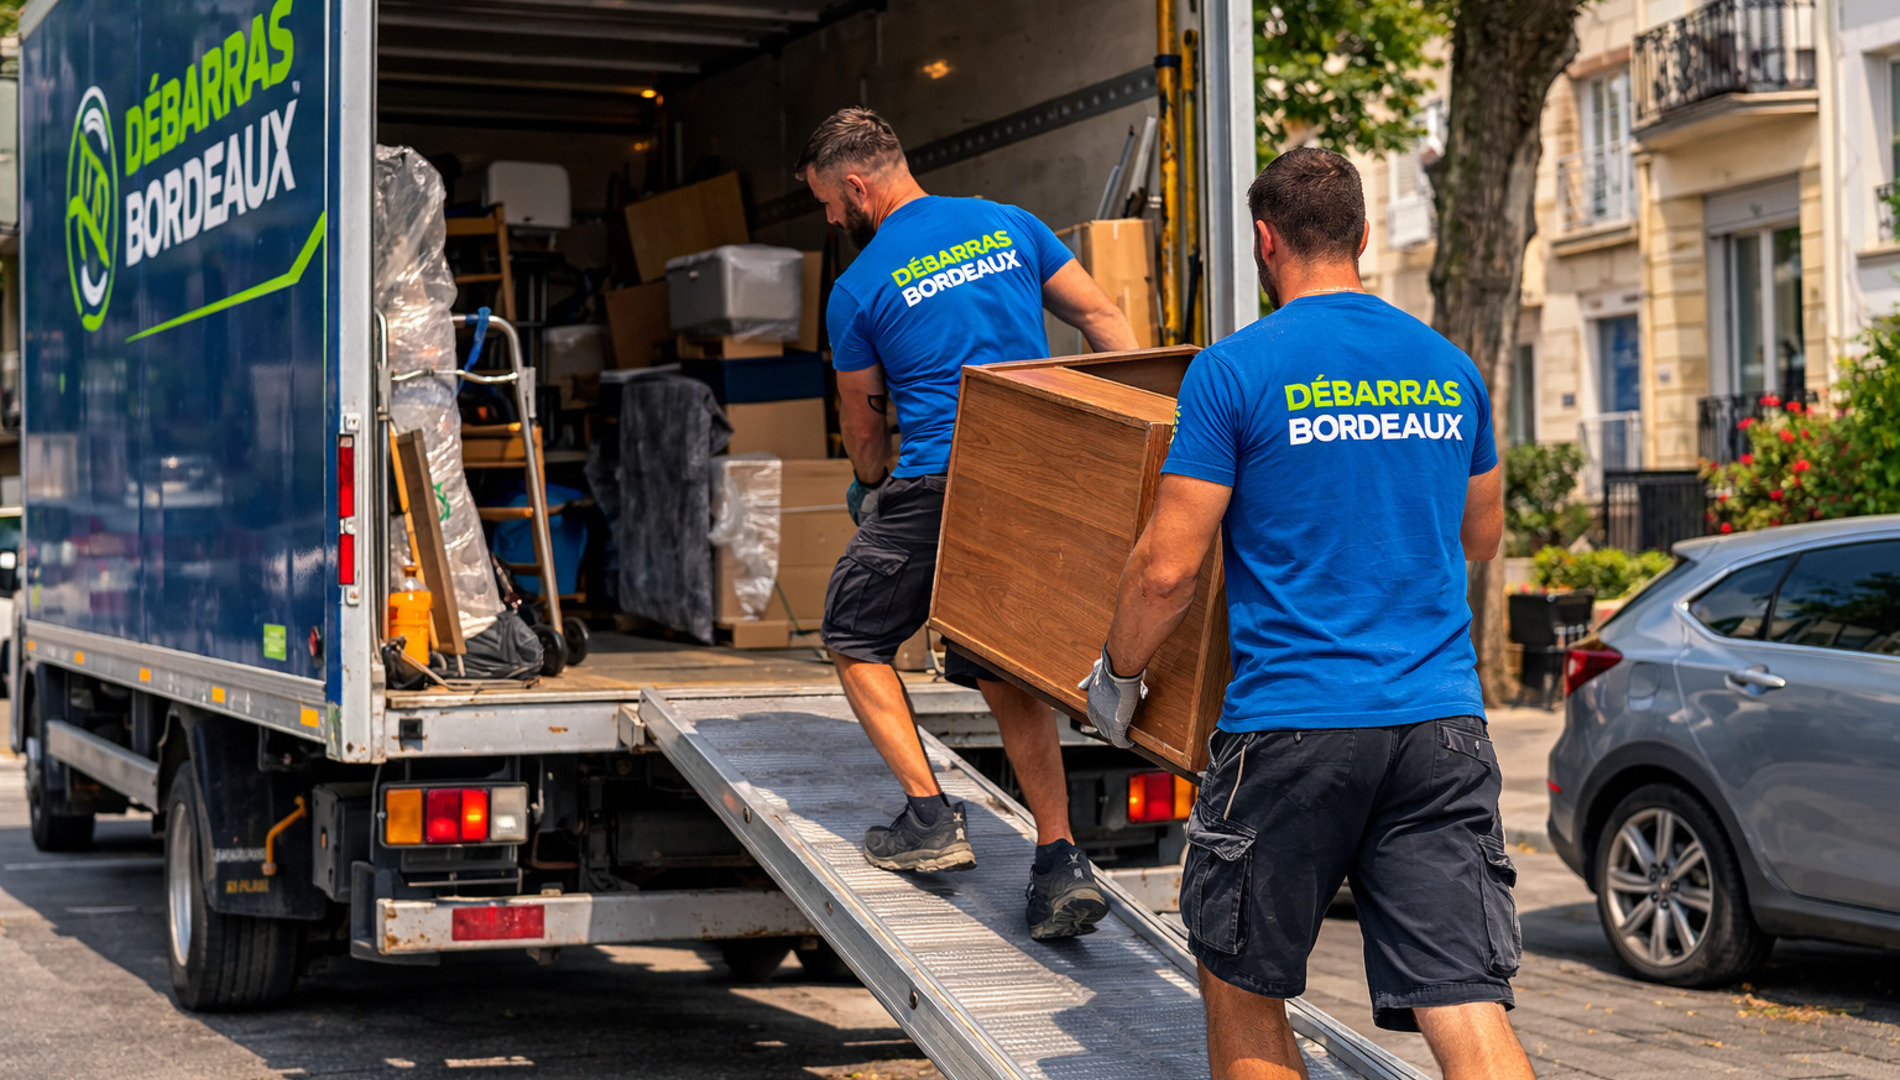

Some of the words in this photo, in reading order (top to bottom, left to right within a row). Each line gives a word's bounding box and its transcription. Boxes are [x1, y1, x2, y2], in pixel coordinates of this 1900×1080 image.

[126, 0, 294, 177] DÉBARRAS
[126, 99, 298, 267] BORDEAUX
[891, 230, 1013, 287] DÉBARRAS
[901, 249, 1022, 308] BORDEAUX
[1284, 374, 1462, 411] DÉBARRAS
[1288, 413, 1463, 446] BORDEAUX
